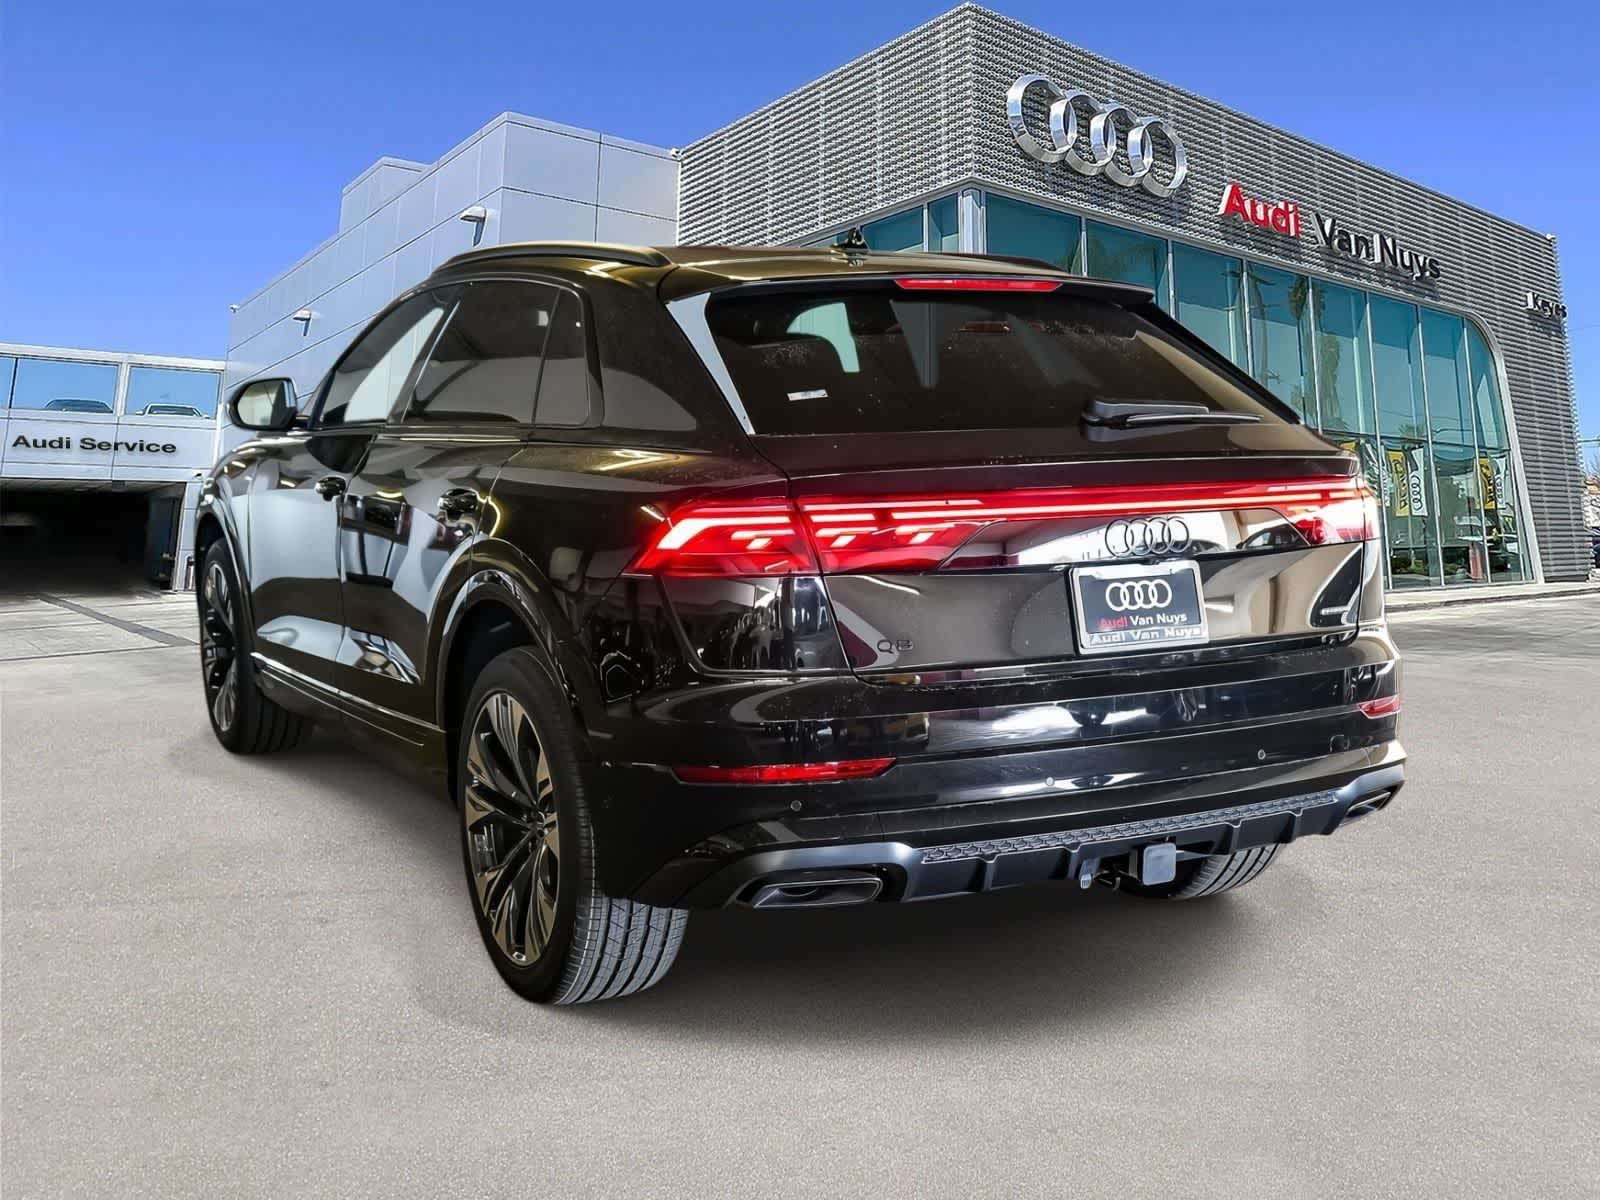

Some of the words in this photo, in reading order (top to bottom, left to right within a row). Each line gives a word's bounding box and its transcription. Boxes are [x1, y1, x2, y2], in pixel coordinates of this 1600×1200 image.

[1219, 183, 1302, 237] Audi
[1311, 211, 1371, 259] Van
[1372, 232, 1442, 281] Nuys
[12, 434, 71, 450] Audi
[79, 437, 177, 454] Service
[1097, 616, 1128, 630] Audi
[1130, 615, 1153, 626] Van
[1156, 612, 1188, 625] Nuys
[1090, 631, 1126, 646] Audi
[1130, 629, 1160, 642] Van
[1164, 624, 1202, 638] Nuys
